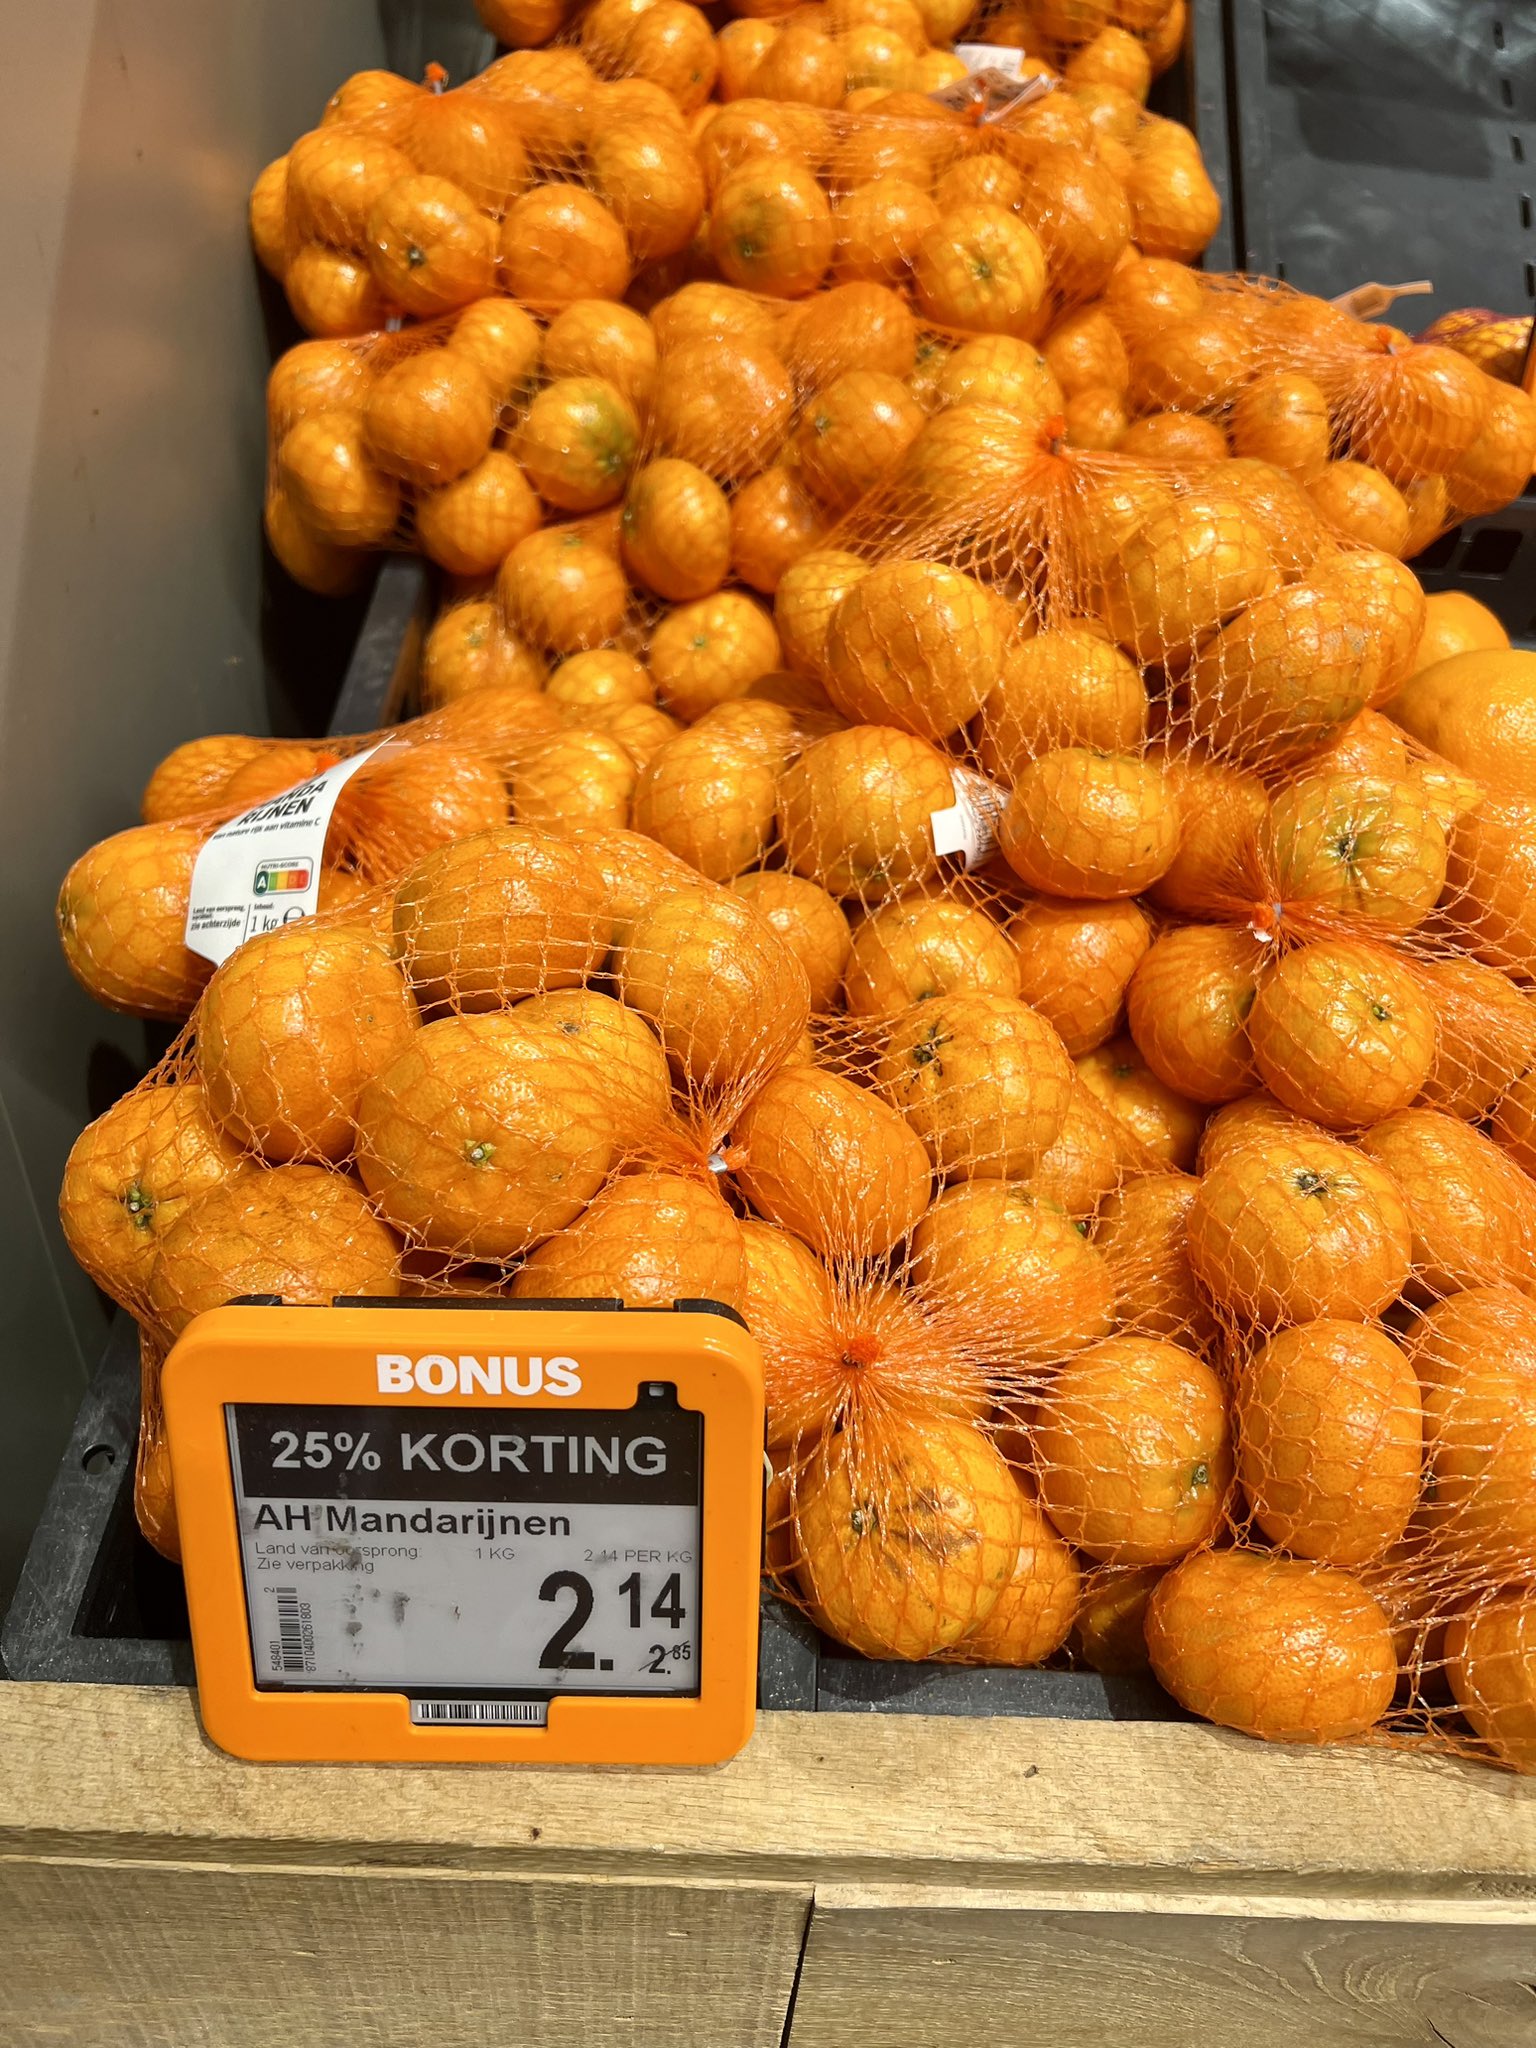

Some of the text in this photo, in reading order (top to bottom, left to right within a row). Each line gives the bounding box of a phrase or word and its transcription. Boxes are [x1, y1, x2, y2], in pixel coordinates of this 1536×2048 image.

[237, 795, 315, 826] RIJNEN
[251, 826, 263, 836] rijk
[263, 824, 279, 833] aan
[279, 818, 314, 830] vitamine
[313, 817, 321, 826] C
[257, 876, 266, 889] A
[201, 918, 241, 930] achterzijde
[250, 916, 258, 932] 1
[376, 1353, 582, 1397] BONUS
[270, 1430, 668, 1475] 25% KORTING
[253, 1503, 571, 1541] AH Mandarijnen
[256, 1542, 297, 1556] Land
[301, 1544, 331, 1556] van
[475, 1547, 515, 1560] 1 KG
[624, 1550, 661, 1563] PER
[667, 1550, 692, 1563] KG
[256, 1557, 375, 1574] Zie verpakkng
[269, 1640, 283, 1671] 548401
